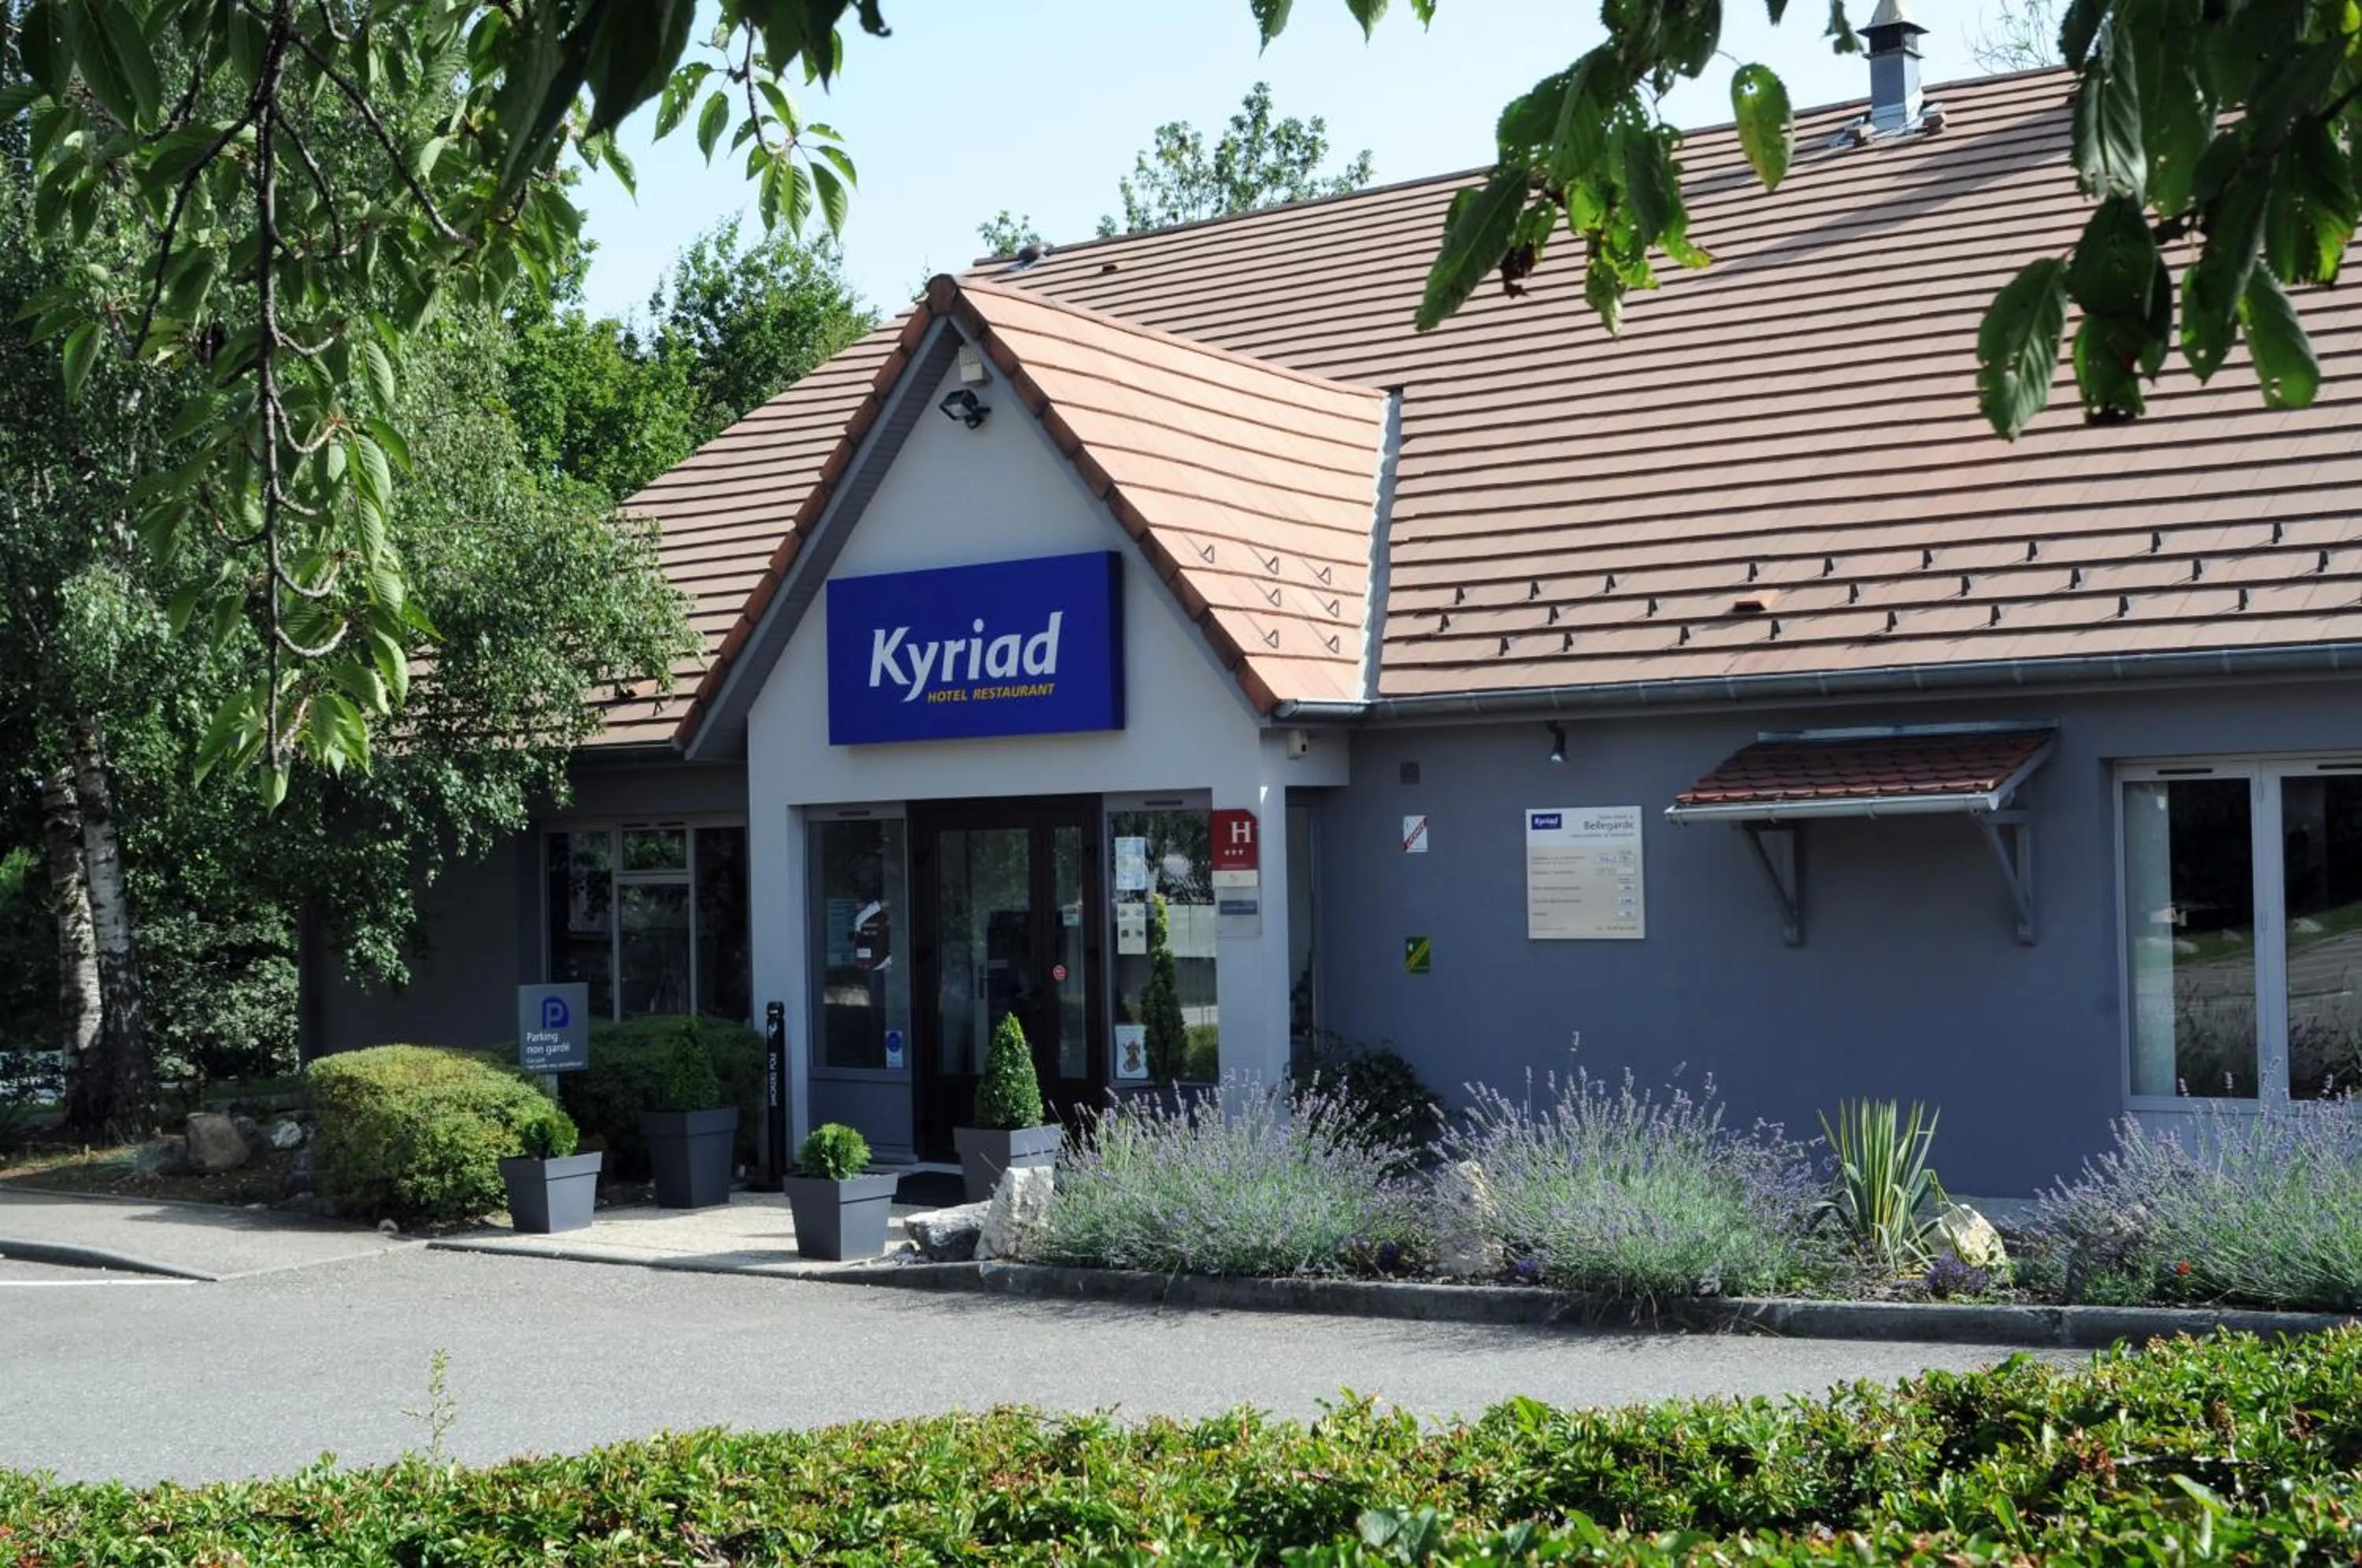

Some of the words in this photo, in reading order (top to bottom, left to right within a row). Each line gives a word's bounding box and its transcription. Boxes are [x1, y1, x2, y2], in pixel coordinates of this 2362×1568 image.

[869, 611, 1063, 702] Kyriad
[927, 690, 968, 703] HOTEL
[972, 683, 1055, 701] RESTAURANT
[1231, 821, 1251, 843] H
[1535, 817, 1559, 827] Kyriad
[543, 997, 568, 1030] P
[527, 1032, 558, 1043] Parking
